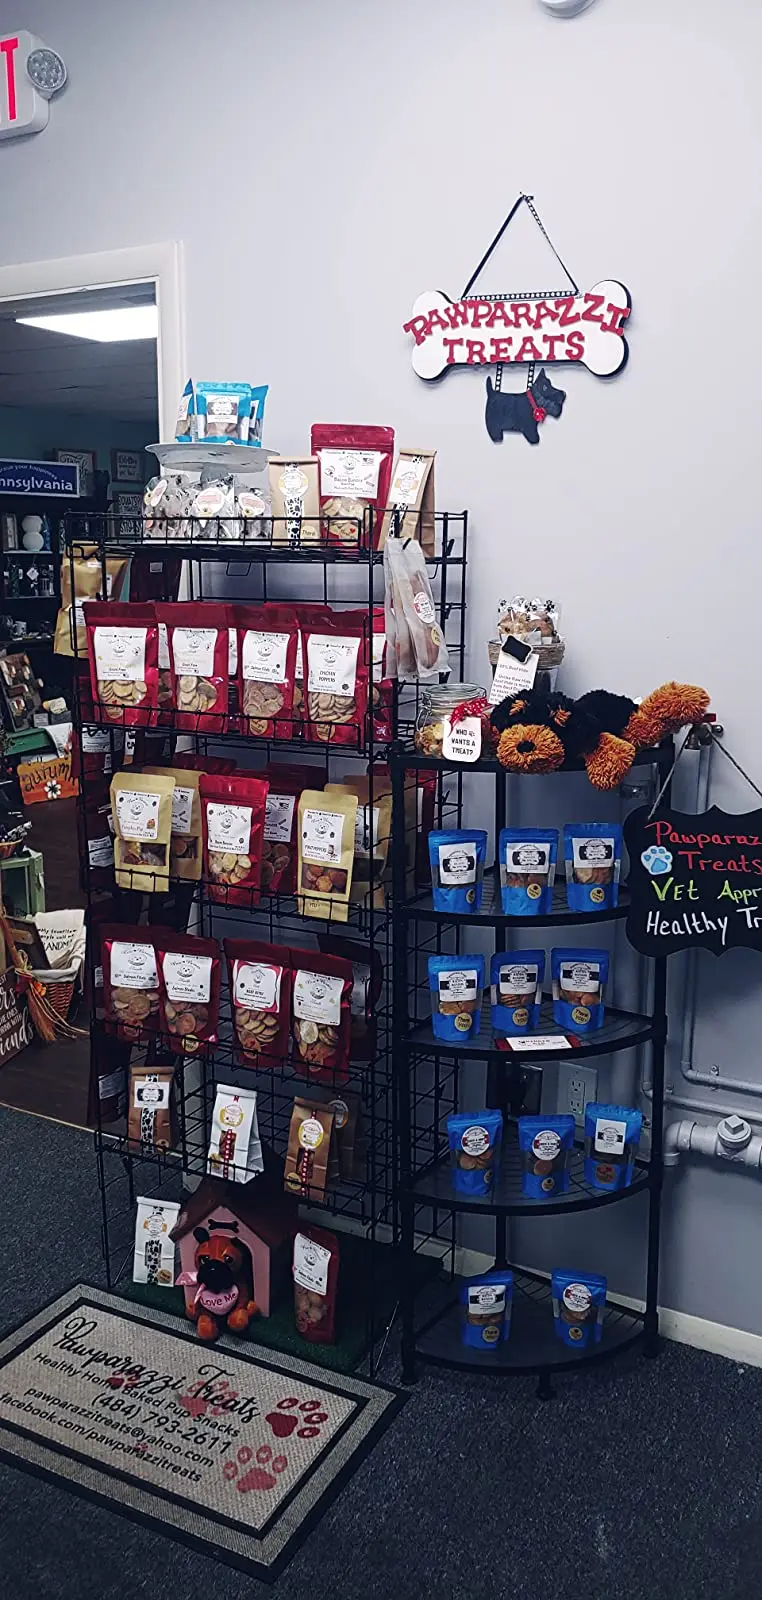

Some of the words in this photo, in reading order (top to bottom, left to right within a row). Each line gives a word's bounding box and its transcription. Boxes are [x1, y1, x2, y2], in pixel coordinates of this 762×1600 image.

[403, 293, 630, 345] PAWPARAZZI
[443, 331, 585, 364] TREATS
[451, 738, 471, 746] WANTS
[452, 746, 474, 755] TREAT?
[24, 762, 76, 792] autumn
[678, 850, 762, 875] Treats
[646, 911, 728, 945] Healthy
[200, 1295, 222, 1307] Love
[223, 1292, 237, 1303] Me
[53, 1317, 187, 1394] Pawparazzi
[193, 1364, 261, 1424] Treats
[33, 1353, 82, 1377] Healthy
[121, 1384, 165, 1409] Baked
[164, 1401, 191, 1419] Pup
[193, 1412, 241, 1438] Snacks
[0, 1392, 202, 1482] facebook.com/pawparazzitreats
[24, 1388, 214, 1468] pawparazzitreats@yahoo.com
[91, 1393, 142, 1420] (484)
[142, 1411, 232, 1455] 793-2611
